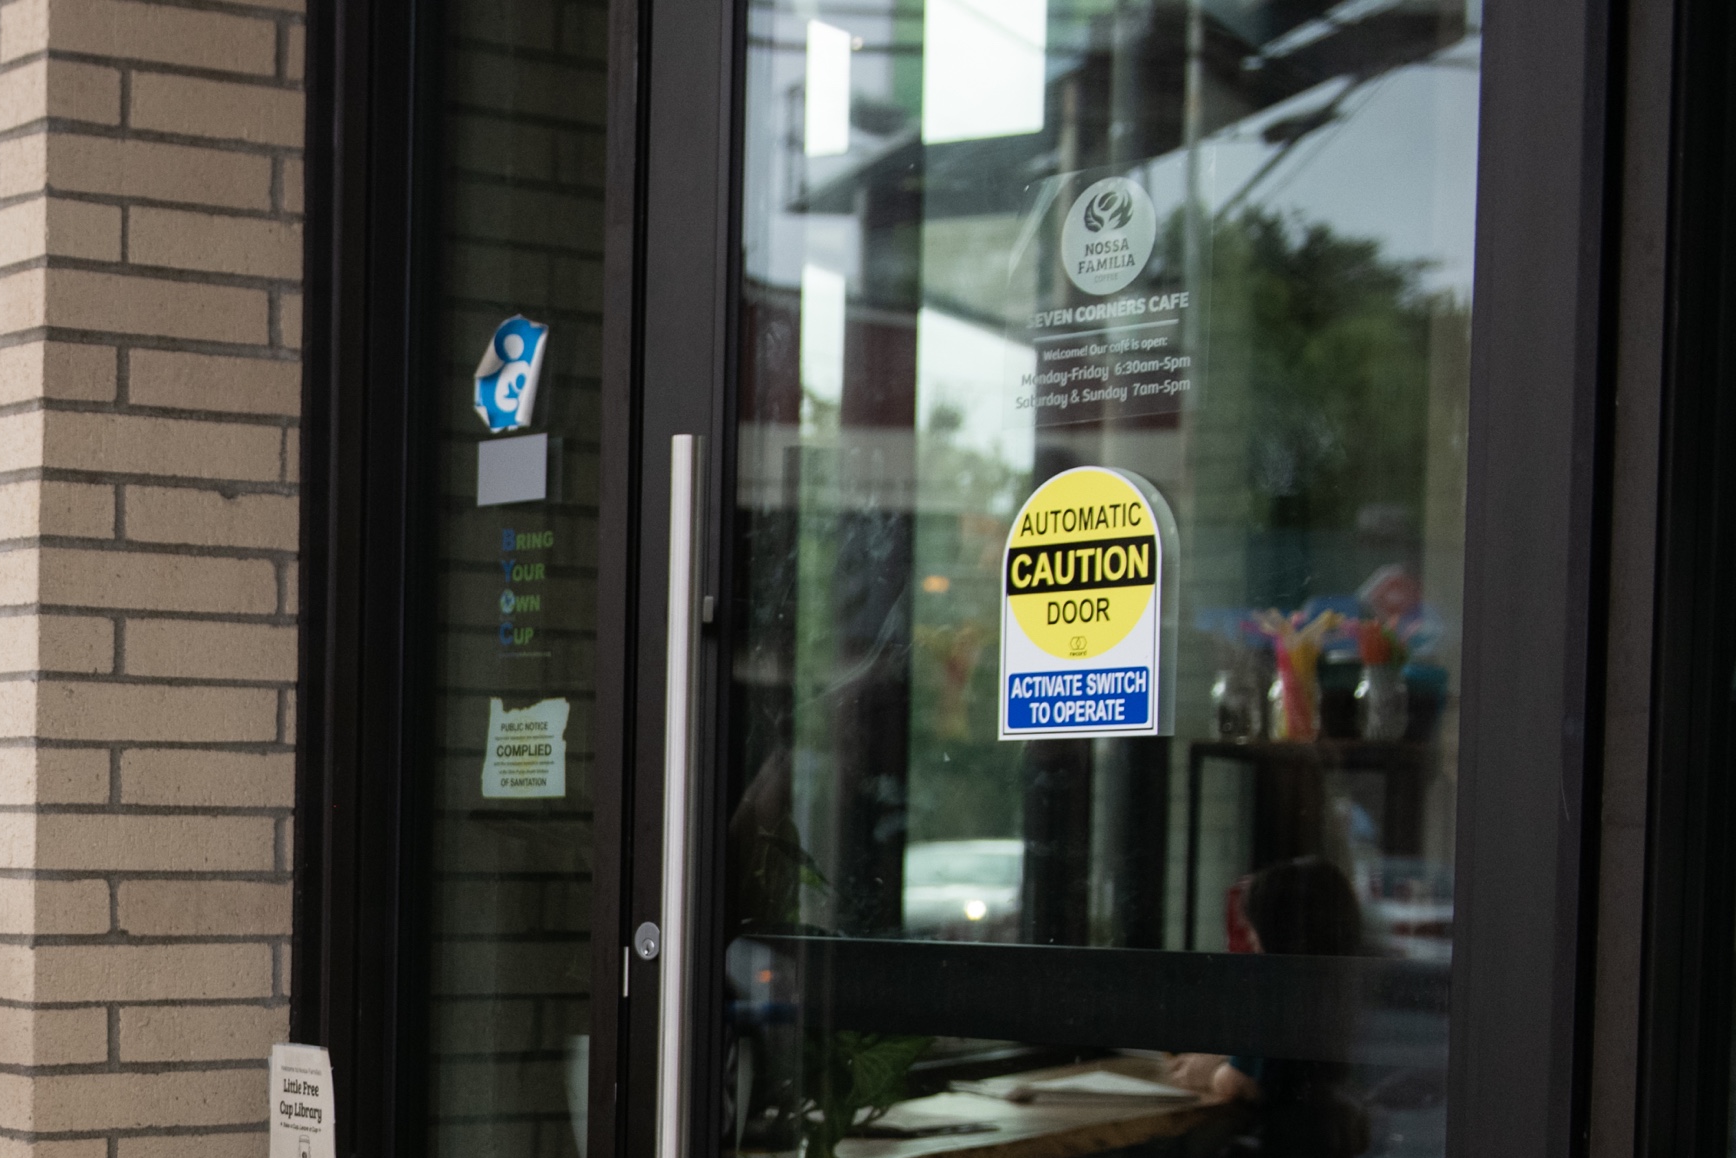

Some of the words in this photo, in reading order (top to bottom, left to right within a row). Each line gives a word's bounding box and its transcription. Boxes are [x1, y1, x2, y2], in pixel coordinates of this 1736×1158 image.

[1085, 238, 1130, 257] NOSSA
[1078, 254, 1135, 274] FAMILIA
[1075, 297, 1146, 323] CORNERS
[1149, 291, 1190, 313] CAFE
[1043, 344, 1089, 362] Welcome!
[1090, 343, 1108, 355] Our
[1131, 337, 1140, 350] is
[1141, 336, 1168, 351] open:
[1021, 365, 1110, 387] Monday-Friday
[1114, 355, 1191, 376] 6:30am-5pm
[1015, 392, 1069, 410] Saturday
[1070, 389, 1080, 404] &
[1082, 385, 1128, 402] Sunday
[1133, 379, 1191, 396] 7am-5pm
[1020, 502, 1142, 537] AUTOMATIC
[502, 528, 554, 550] BRING
[500, 559, 545, 582] YOUR
[1010, 543, 1149, 589] CAUTION
[500, 588, 541, 614] OWN
[1047, 597, 1110, 625] DOOR
[499, 621, 534, 645] CUP
[1010, 672, 1082, 699] ACTIVATE
[1086, 670, 1147, 696] SWITCH
[1029, 702, 1050, 724] TO
[1053, 698, 1125, 722] OPERATE
[500, 722, 523, 732] PUBLIC
[524, 721, 548, 732] NOTICE
[496, 743, 552, 757] COMPLIED
[500, 778, 510, 787] OF
[510, 777, 547, 787] SANITATION
[283, 1078, 302, 1095] Little
[303, 1081, 319, 1098] Free
[279, 1100, 293, 1120] Cup
[294, 1102, 322, 1125] Library
